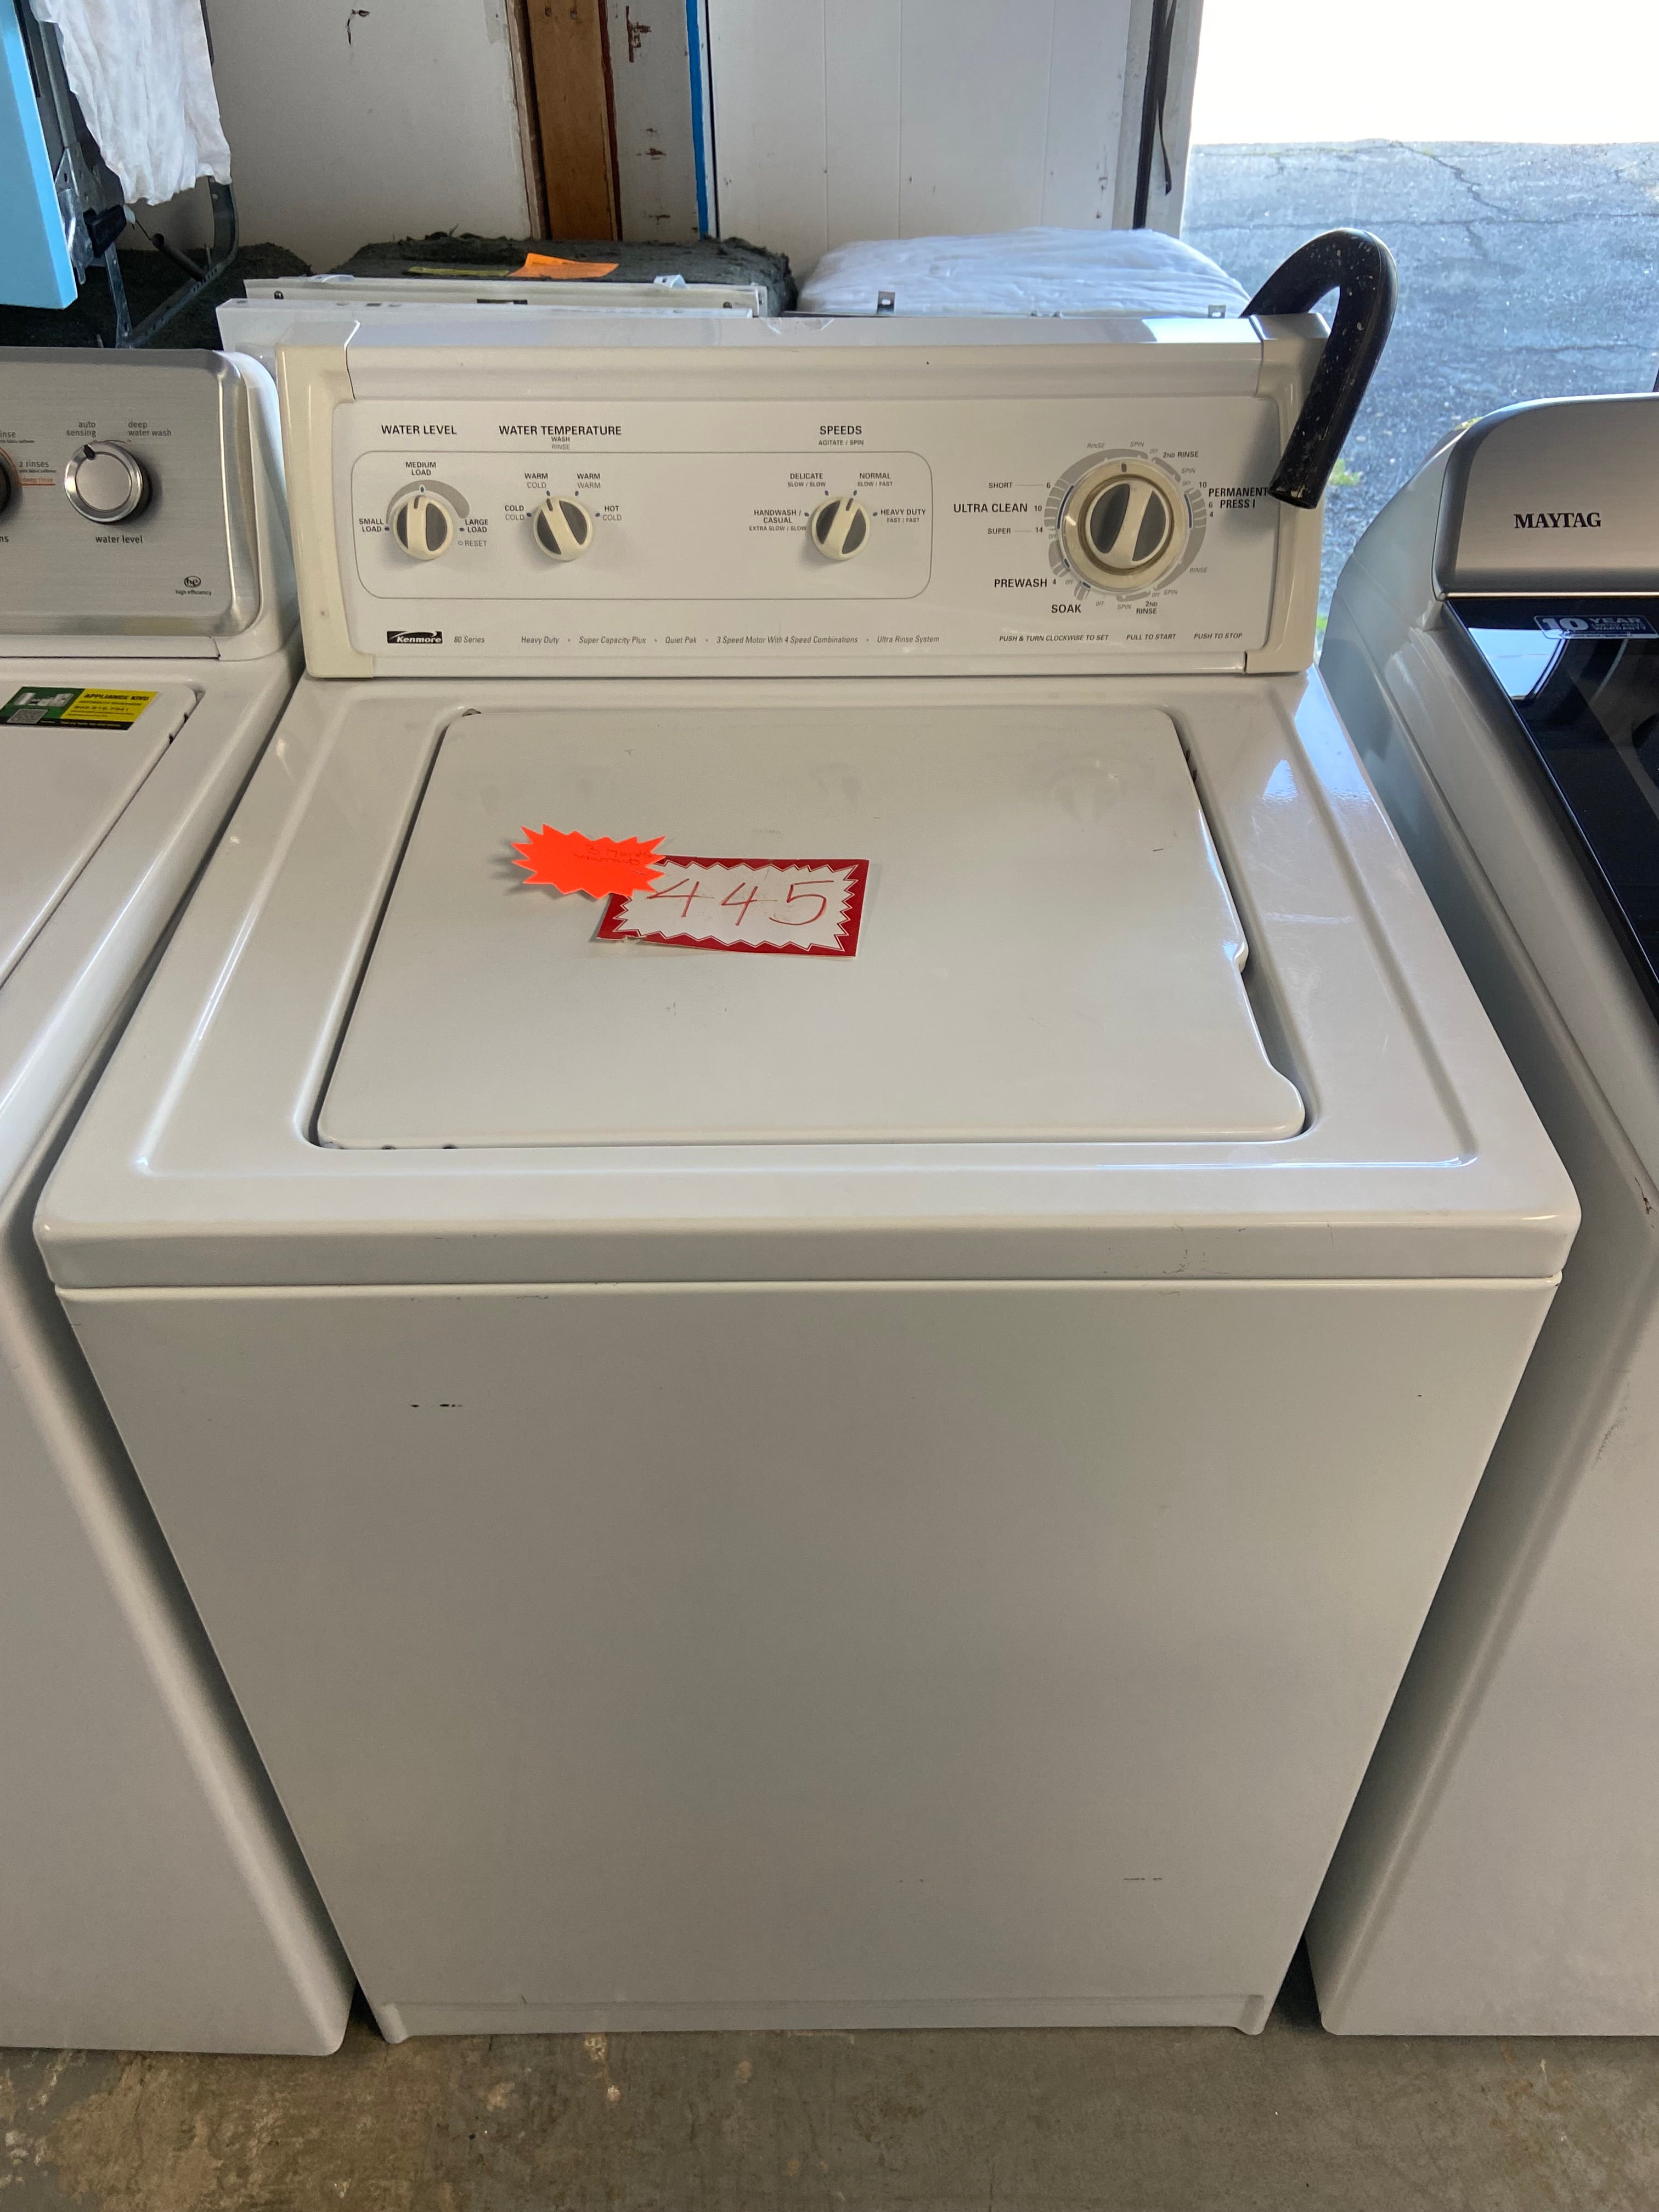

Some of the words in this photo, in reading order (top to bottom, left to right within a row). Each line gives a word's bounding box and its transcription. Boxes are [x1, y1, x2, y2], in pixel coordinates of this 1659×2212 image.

[128, 420, 148, 430] deep
[381, 425, 420, 434] WATER
[424, 425, 457, 434] LEVEL
[66, 429, 96, 438] sensing
[499, 426, 538, 435] WATER
[541, 426, 622, 435] TEMPERATURE
[820, 426, 862, 435] SPEEDS
[1209, 487, 1268, 497] PERMANENT
[953, 504, 988, 512] ULTRA
[992, 503, 1028, 512] CLEAN
[1220, 499, 1250, 509] PRESS
[1514, 512, 1601, 528] MAYTAG
[122, 535, 143, 543] level
[994, 578, 1047, 588] PREWASH
[1051, 604, 1081, 613] SOAK
[1542, 618, 1589, 631] 10
[521, 636, 542, 645] Heavy
[544, 636, 560, 645] Duty
[579, 636, 599, 645] Super
[601, 636, 630, 645] Capacity
[723, 636, 743, 645] Speed
[791, 636, 811, 644] Speed
[813, 635, 858, 644] Combinations
[915, 635, 940, 644] System
[646, 878, 834, 926] 445
